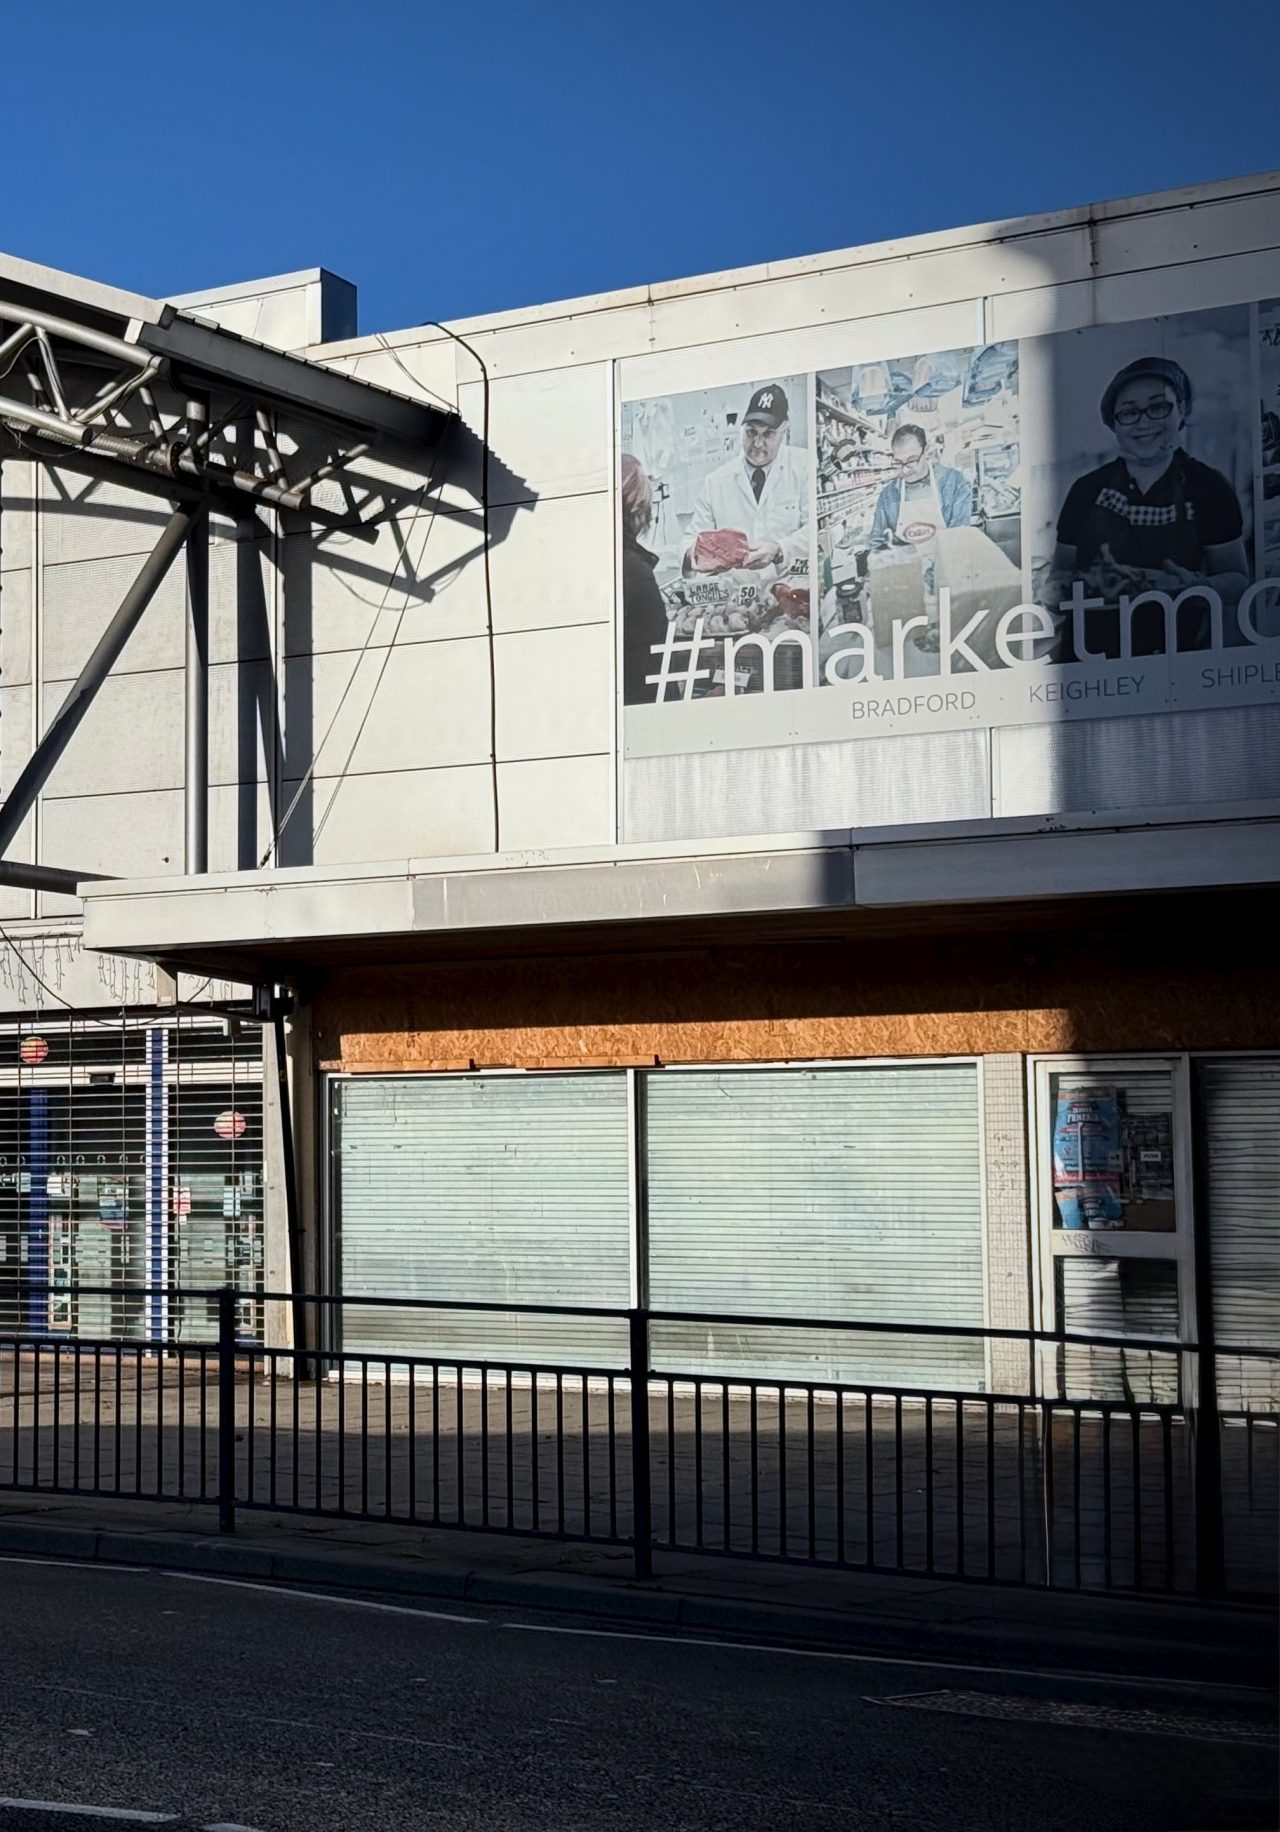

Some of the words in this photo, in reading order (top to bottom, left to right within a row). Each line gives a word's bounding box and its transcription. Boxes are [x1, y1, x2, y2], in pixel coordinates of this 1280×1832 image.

[689, 582, 720, 593] LARGE
[740, 586, 756, 598] 50
[852, 691, 976, 720] BRADFORD
[1029, 675, 1146, 704] KEIGHLEY
